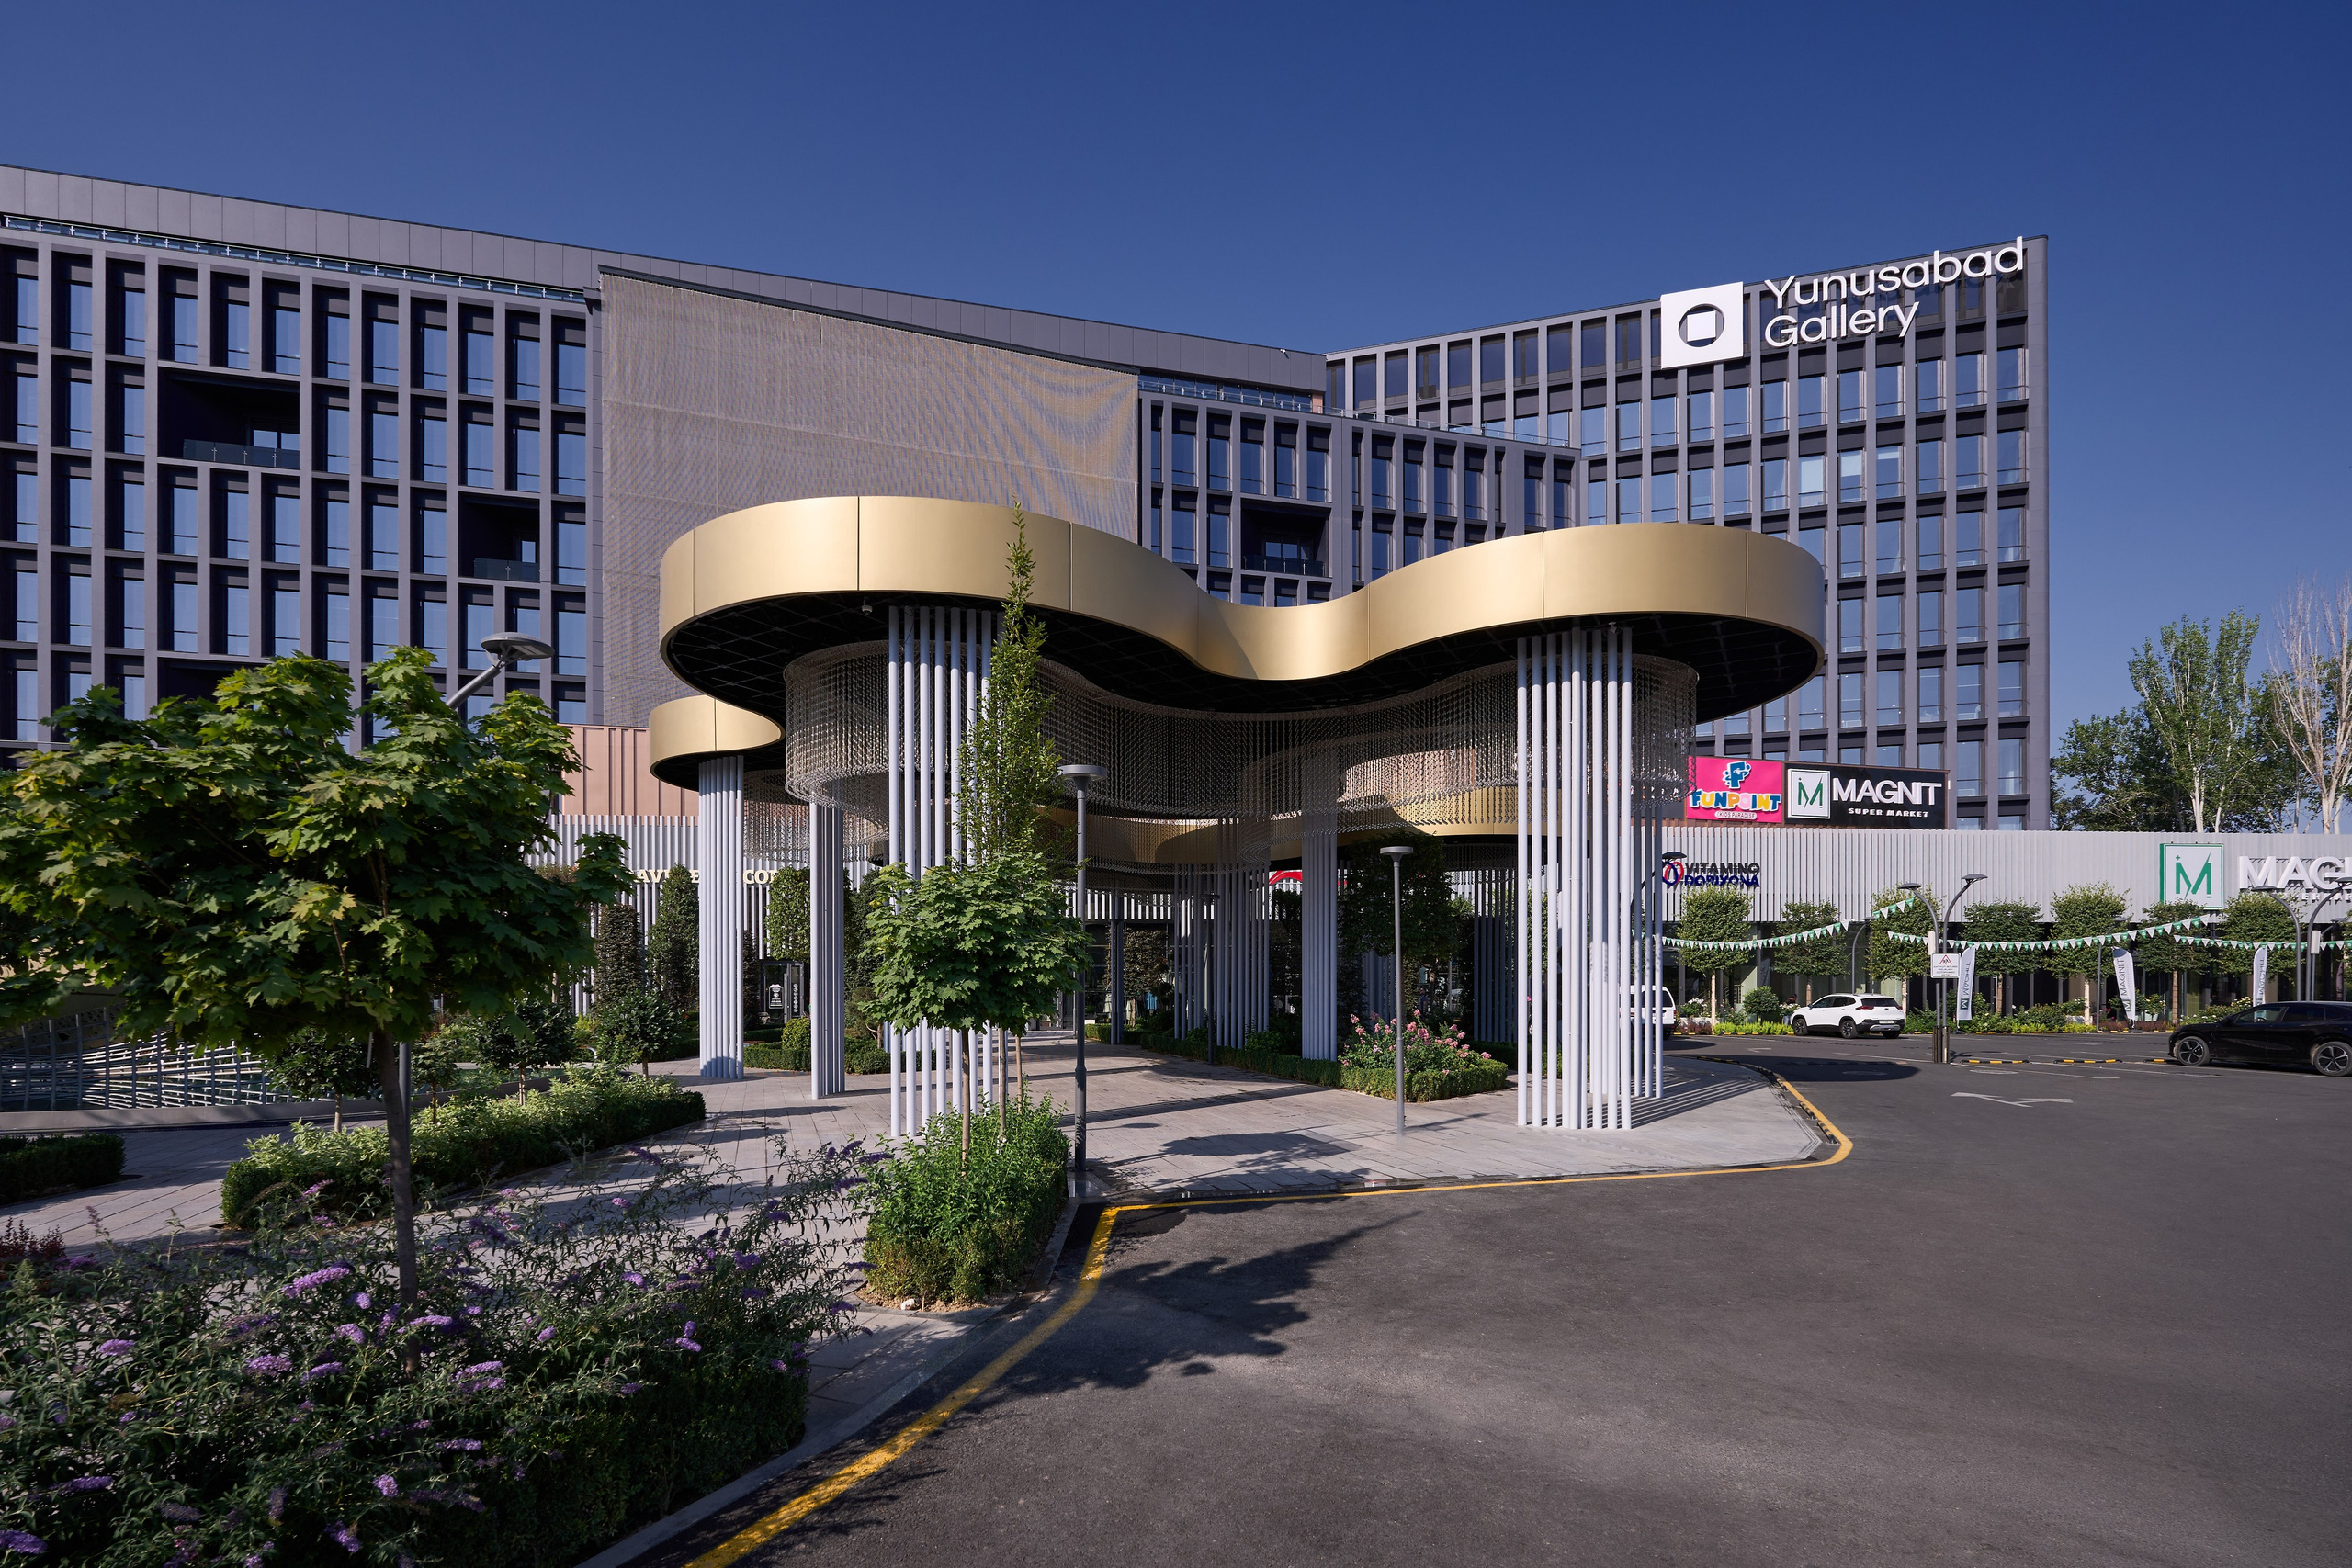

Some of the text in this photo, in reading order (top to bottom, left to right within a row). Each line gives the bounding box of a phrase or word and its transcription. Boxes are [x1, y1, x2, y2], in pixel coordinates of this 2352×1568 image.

[1764, 235, 2023, 310] Yunusabad
[1764, 300, 1920, 348] Gallery
[1689, 789, 1782, 812] FUNPOINT
[1832, 777, 1943, 807] MAGNIT
[1848, 807, 1929, 818] SUPER MARKET
[2238, 855, 2352, 890] MAG
[2117, 958, 2128, 997] MAGNIT
